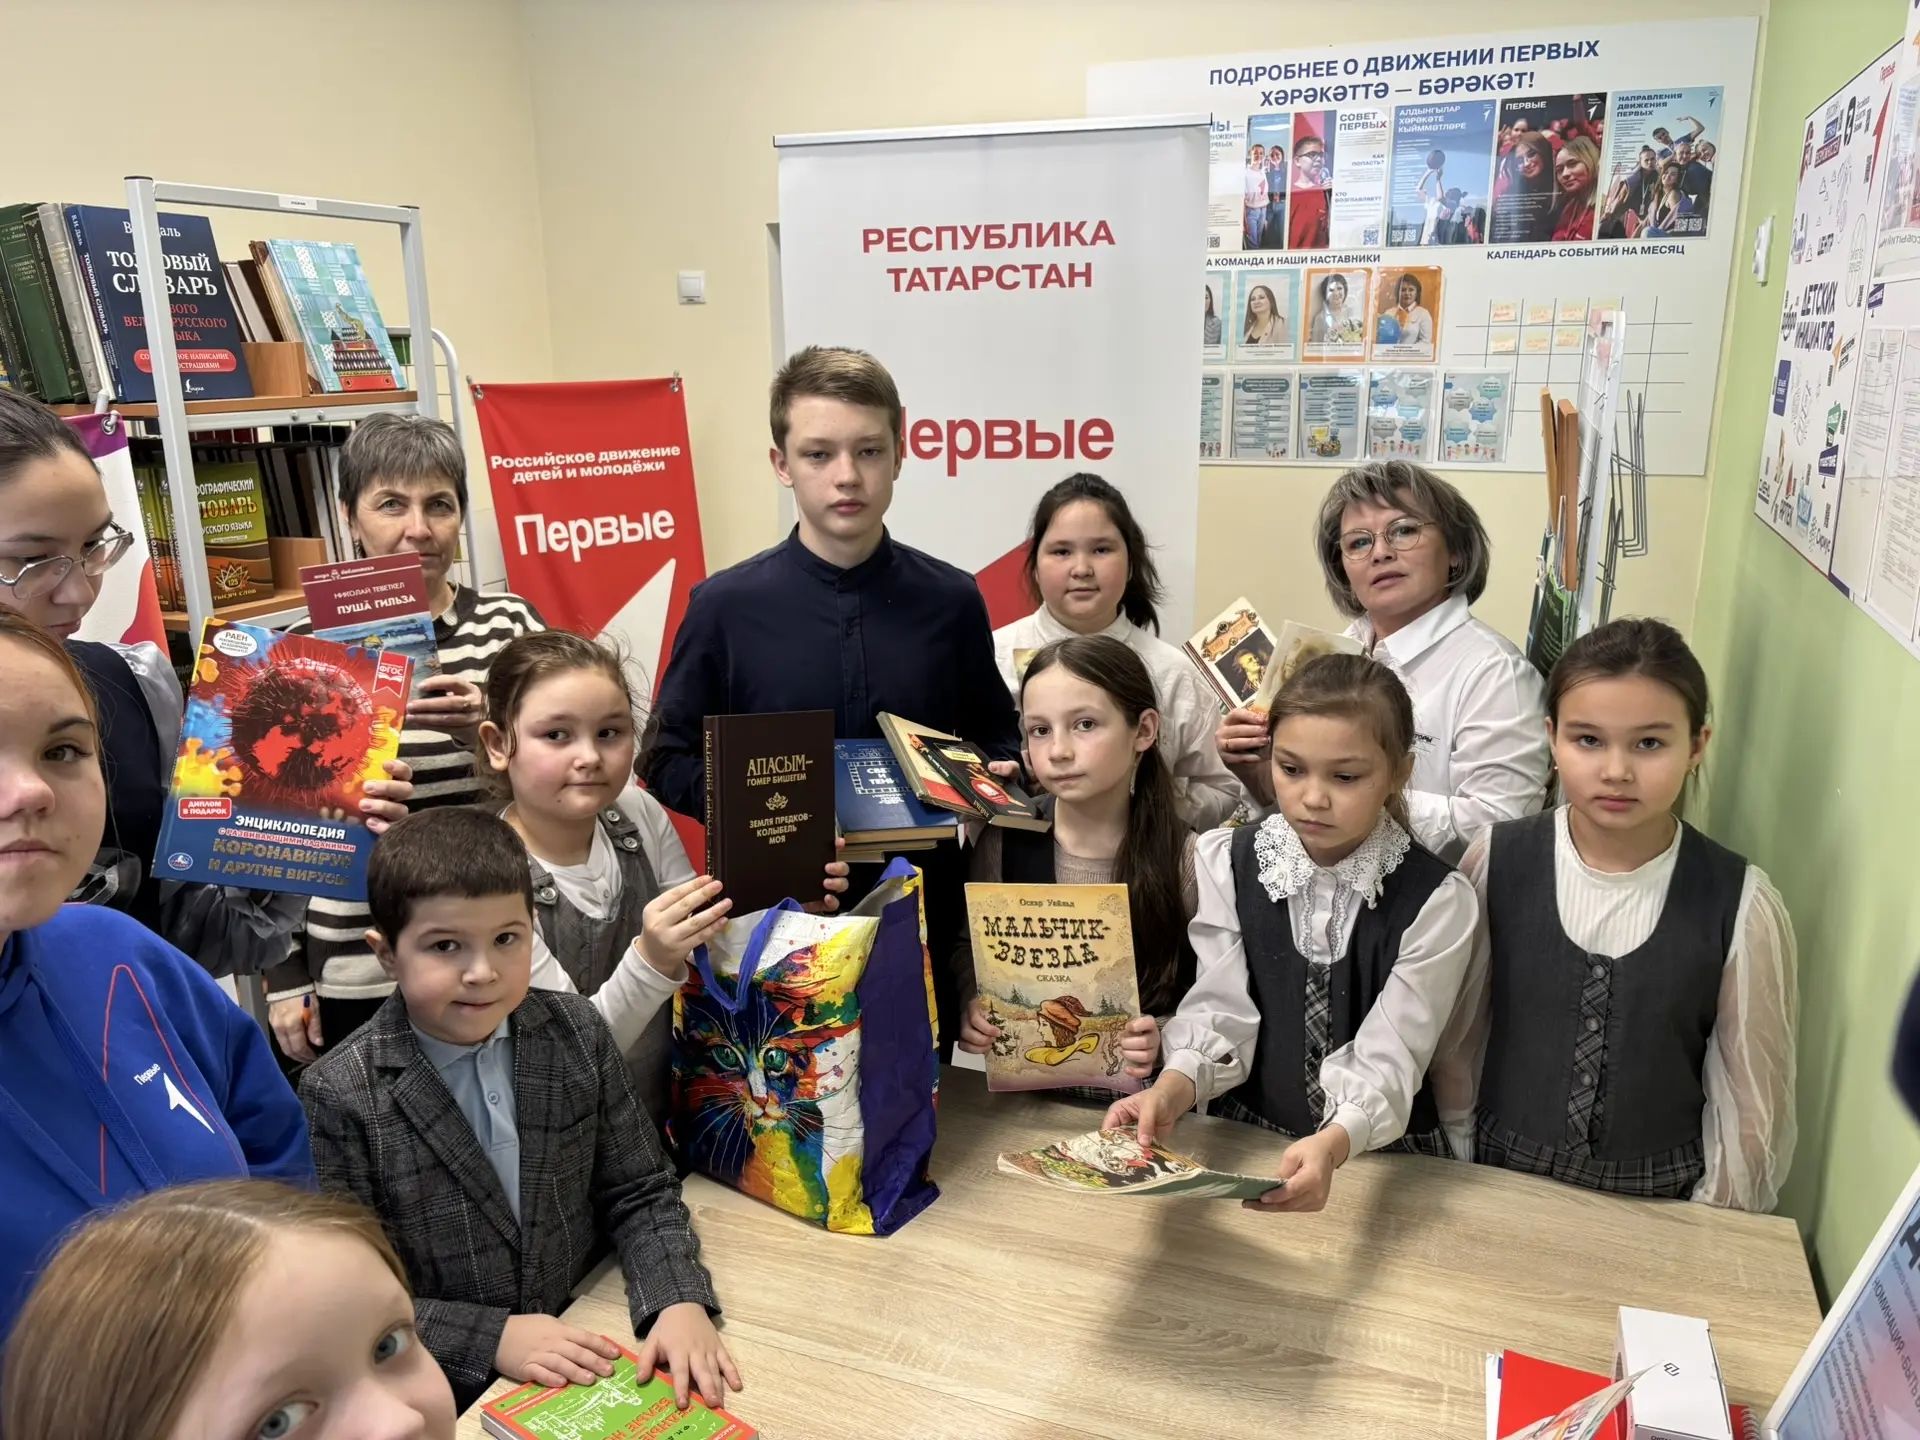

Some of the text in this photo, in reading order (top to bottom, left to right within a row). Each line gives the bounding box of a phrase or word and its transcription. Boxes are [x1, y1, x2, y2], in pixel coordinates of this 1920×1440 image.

[1209, 40, 1600, 86] ПОДРОБНЕЕ О ДВИЖЕНИИ ПЕРВЫХ
[1260, 82, 1389, 107] ХӘРӘКӘТТӘ
[1418, 71, 1535, 96] БӘРӘКӘТ!
[1618, 93, 1682, 102] НАПРАВЛЕНИЯ
[1399, 105, 1461, 117] АЛДЫНГЫЛАР
[1505, 101, 1547, 111] ПЕРВЫЕ
[1616, 102, 1668, 111] ДВИЖЕНИЯ
[1616, 110, 1654, 118] ПЕРВЫХ
[1340, 112, 1378, 122] СОВЕТ
[1340, 120, 1387, 131] ПЕРВЫХ
[862, 220, 1116, 253] РЕСПУБЛИКА
[106, 250, 212, 272] ТОВЫЙ
[1215, 255, 1264, 267] КОМАНДА
[1267, 255, 1274, 265] И
[1277, 254, 1309, 265] НАШИ
[1311, 254, 1381, 264] НАСТАВНИКИ
[1487, 245, 1685, 260] КАЛЕНДАРЬ СОБЫТИЙ НА МЕСЯЦ
[112, 273, 218, 296] СЛВАРЬ
[886, 262, 1093, 292] ТАТАРСТАН
[83, 253, 99, 297] ТОЛКОВЫЙ
[95, 298, 109, 334] СЛОВАРЬ
[1801, 281, 1838, 316] ДЕТСКИХ
[123, 316, 227, 328] ВЕЛРУССКОГО
[900, 407, 1115, 477] ервые
[491, 446, 681, 469] Российское движение
[512, 459, 665, 484] детей и молодёжи
[196, 478, 255, 496] ОГРАФИЧЕСКИЙ
[199, 497, 257, 519] ЛОВАРЬ
[202, 521, 252, 536] УССКОГО ЯЗЫКА
[514, 508, 675, 563] Первые
[150, 539, 162, 578] РУССКОГО
[334, 582, 405, 599] НИКОЛАЙ ТЕВЕТКЕЛ
[374, 594, 416, 609] ГИЛЬЗА
[225, 631, 248, 642] РАЕН
[379, 665, 404, 676] ФГОС
[747, 773, 806, 787] ГОМЕР БИШЕГЕМ
[190, 807, 227, 815] ПОДАРОК
[235, 815, 346, 840] ЭНЦИКЛОПЕДИЯ
[749, 817, 773, 828] ЗЕМЛЯ
[757, 825, 797, 837] КОЛЫБЕЛЬ
[226, 828, 302, 845] РАЗВИВАЮЩИМИ
[303, 838, 356, 852] ЗАДАНИЯМИ
[769, 836, 786, 844] МОЯ
[208, 858, 220, 871] И
[222, 859, 283, 878] ДРУГИЕ
[1019, 898, 1043, 908] Оскар
[982, 915, 1111, 940] МАЛЬЧИК-
[1036, 974, 1071, 983] СКАЗКА
[133, 1063, 161, 1086] Первые
[1873, 1279, 1905, 1356] НОМИНАЦИЯ
